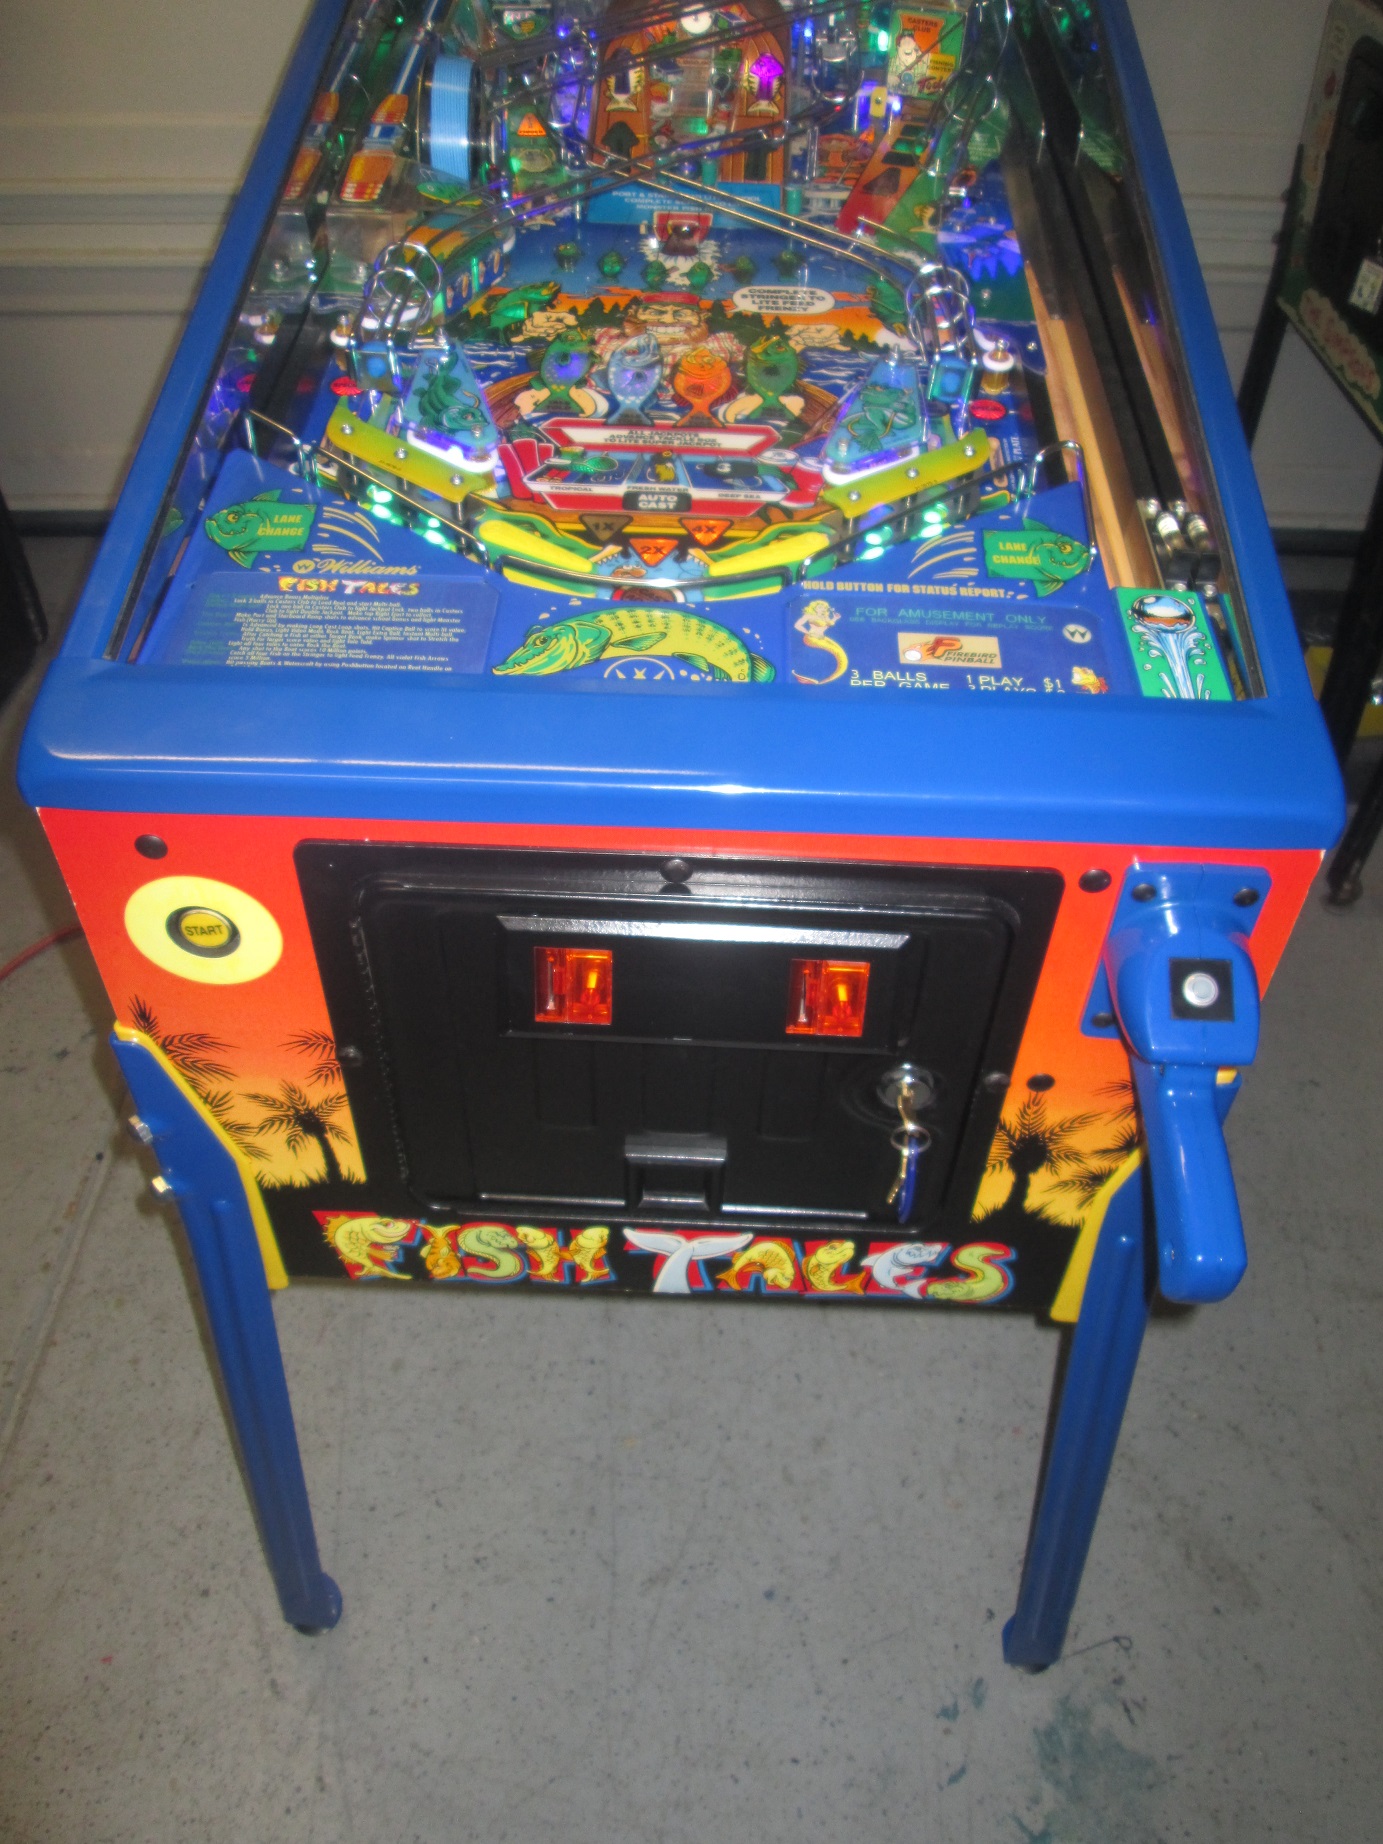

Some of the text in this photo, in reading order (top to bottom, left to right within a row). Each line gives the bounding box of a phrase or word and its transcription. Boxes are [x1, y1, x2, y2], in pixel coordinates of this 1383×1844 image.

[638, 502, 676, 510] CAST
[274, 514, 303, 524] LANE
[258, 527, 305, 536] CHANGE
[640, 545, 666, 555] 2X
[998, 542, 1027, 552] LANE
[992, 554, 1041, 566] CHANGE
[317, 558, 418, 576] Williams
[803, 580, 834, 590] HOLD
[836, 582, 884, 593] BUTTON
[887, 584, 910, 594] FOR
[912, 584, 958, 596] STATUS
[856, 607, 1047, 625] FOR AMUSEMENT ONLY
[944, 656, 996, 665] PINBALL
[946, 650, 998, 660] FIREBIRD
[850, 670, 927, 682] 3 BALLS
[966, 674, 972, 684] 1
[979, 676, 1024, 687] PLAY
[1044, 677, 1062, 689] $1
[184, 924, 224, 936] START
[313, 1211, 1018, 1304] FISH TALES
